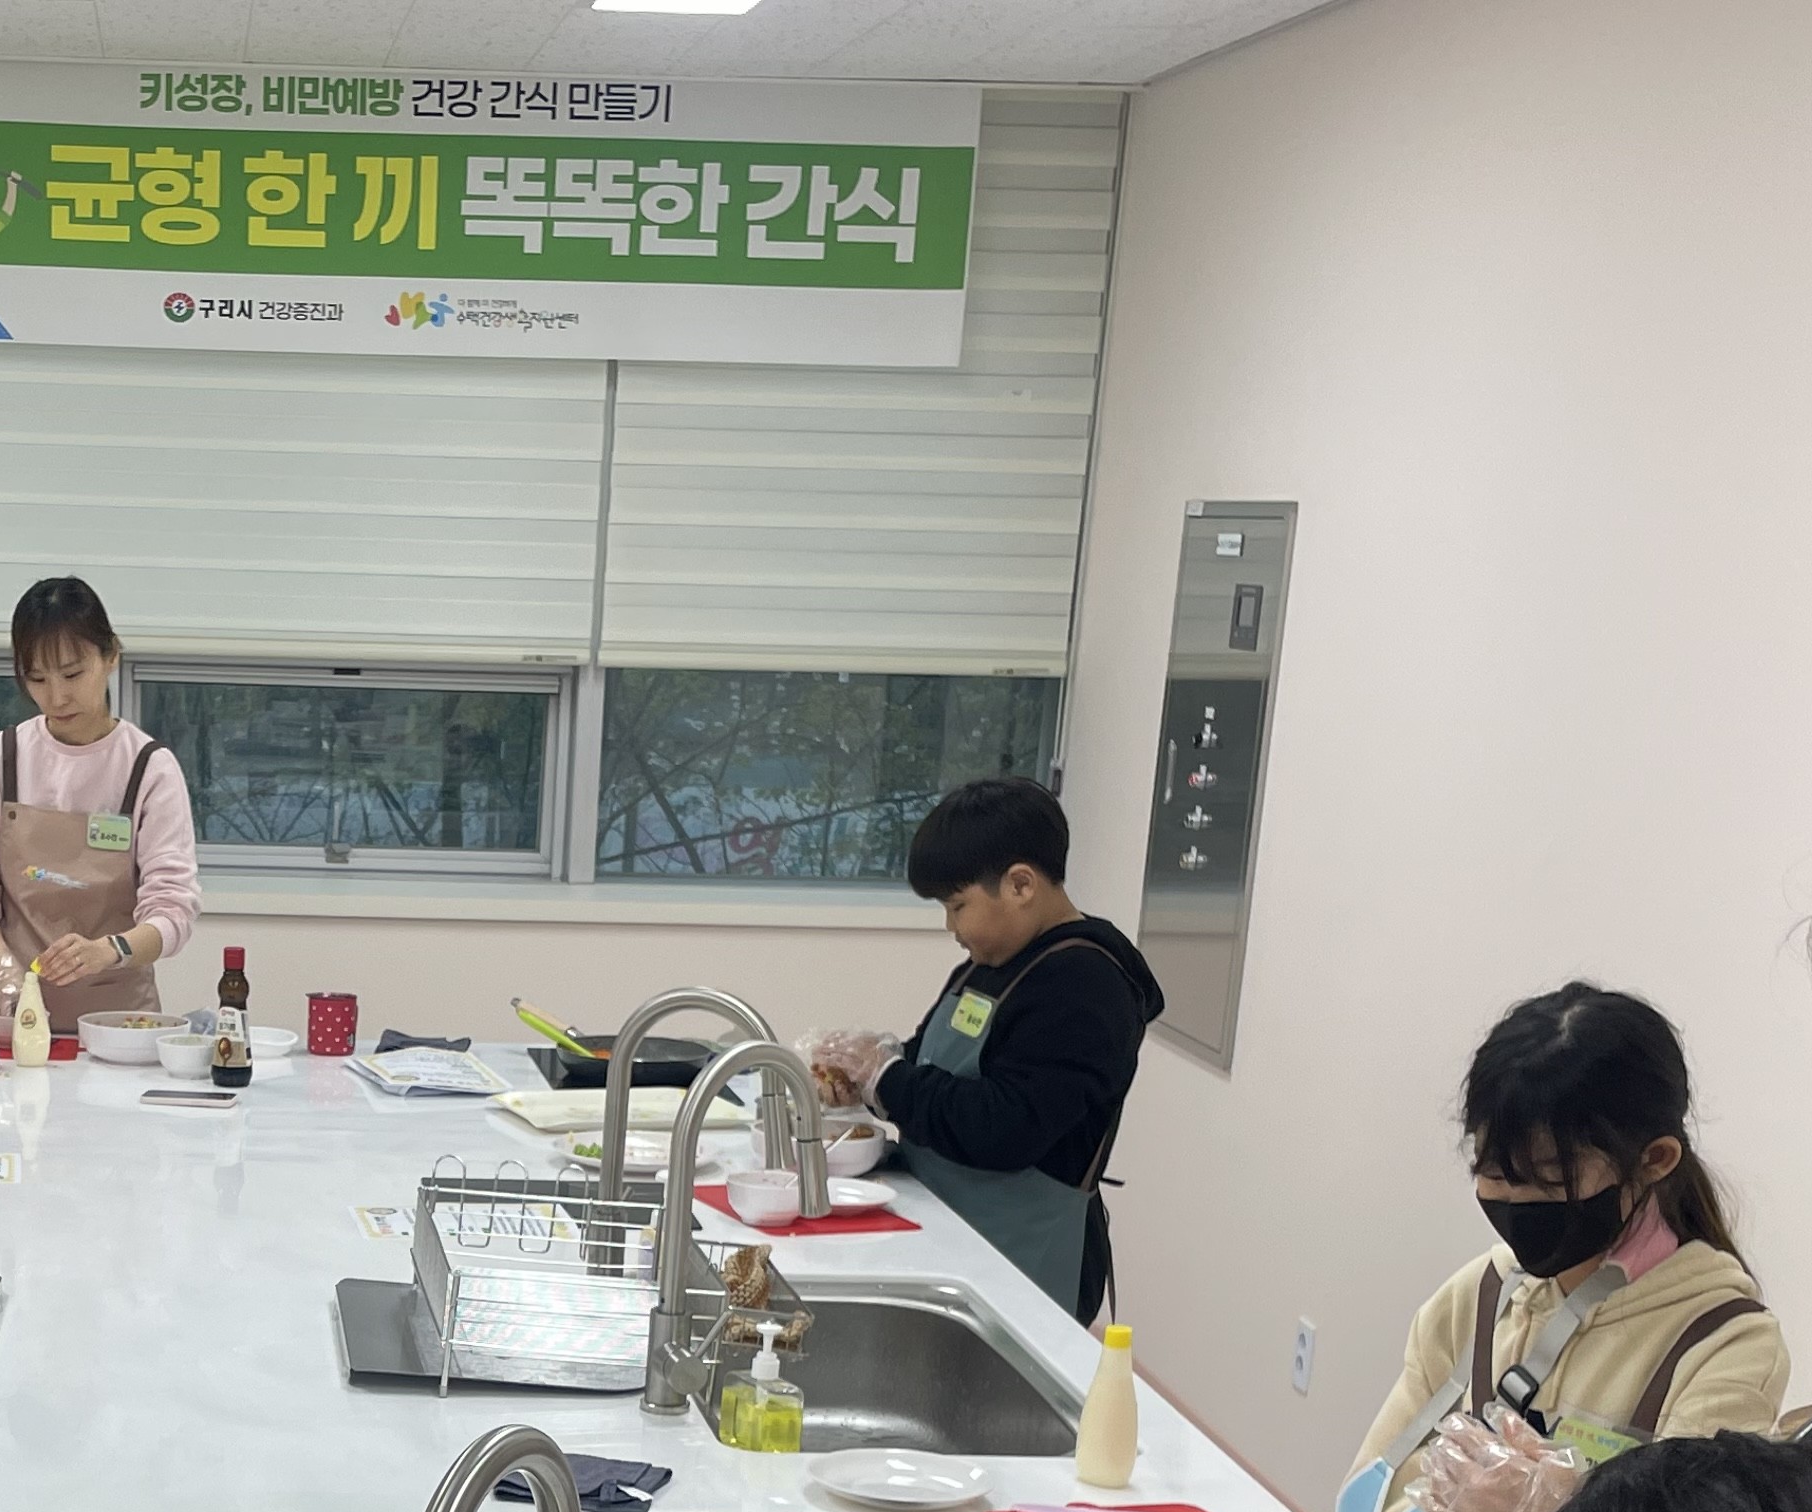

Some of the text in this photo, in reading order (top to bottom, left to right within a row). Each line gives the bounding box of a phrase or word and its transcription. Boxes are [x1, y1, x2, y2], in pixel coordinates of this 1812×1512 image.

[139, 73, 672, 123] 키성장, 비만예방 건강 간식 만들기
[45, 144, 922, 265] 균형 한 끼 똑똑한 간식
[198, 299, 345, 322] 구리시 건강증진과
